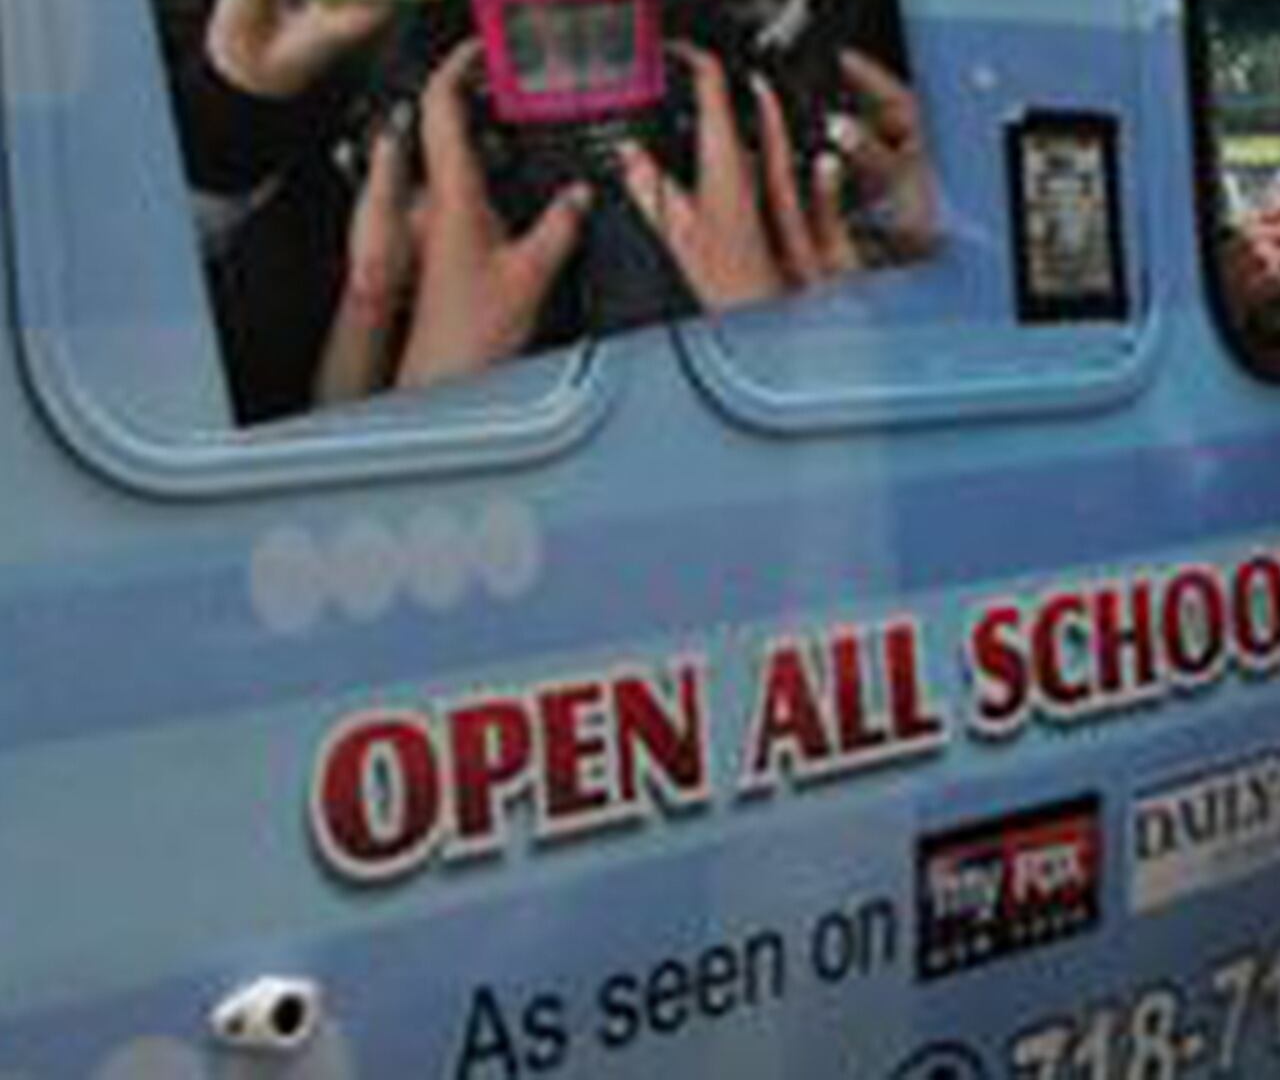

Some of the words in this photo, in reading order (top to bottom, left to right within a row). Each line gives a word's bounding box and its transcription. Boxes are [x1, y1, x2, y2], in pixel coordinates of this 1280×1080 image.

[314, 654, 710, 881] OPEN
[739, 616, 948, 796] ALL
[1010, 842, 1092, 903] FOX
[455, 984, 568, 1080] As
[597, 928, 786, 1048] seen
[812, 895, 898, 983] on
